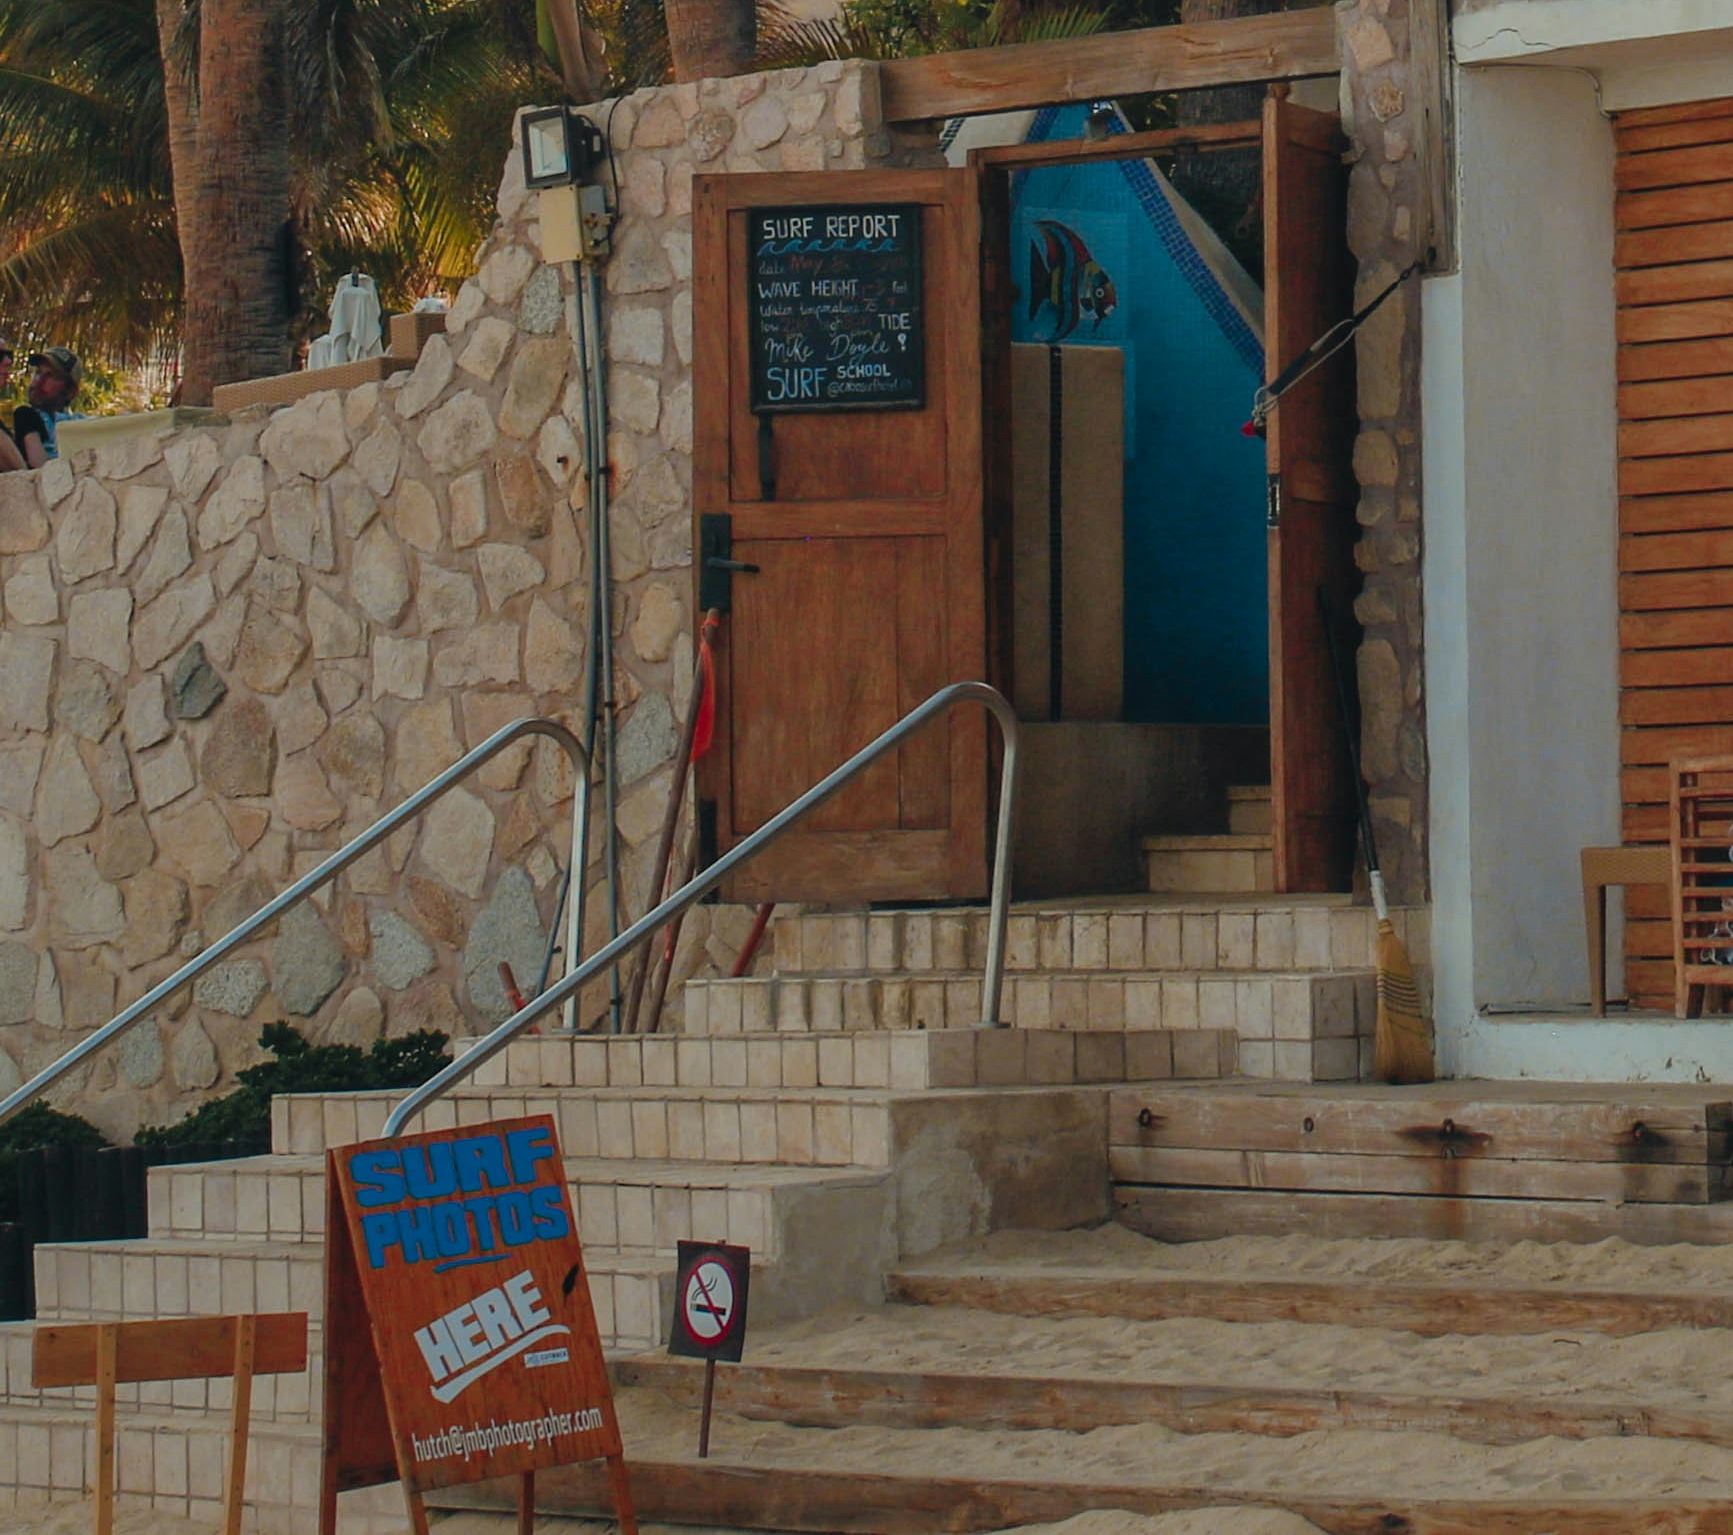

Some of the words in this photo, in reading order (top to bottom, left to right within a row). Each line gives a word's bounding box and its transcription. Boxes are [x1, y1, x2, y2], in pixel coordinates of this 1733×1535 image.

[763, 217, 814, 239] SURF
[826, 215, 900, 238] REPORT
[758, 281, 801, 299] WAVE
[811, 279, 859, 298] HEIGHT
[878, 313, 911, 330] TIDE
[826, 333, 889, 368] Doyle
[767, 367, 828, 401] SURF
[836, 363, 892, 379] SCHOOL
[350, 1127, 554, 1207] SURF
[361, 1185, 569, 1268] PHOTOS
[414, 1269, 551, 1382] HERE
[412, 1408, 604, 1462] hutch@jmbphotographer.com
